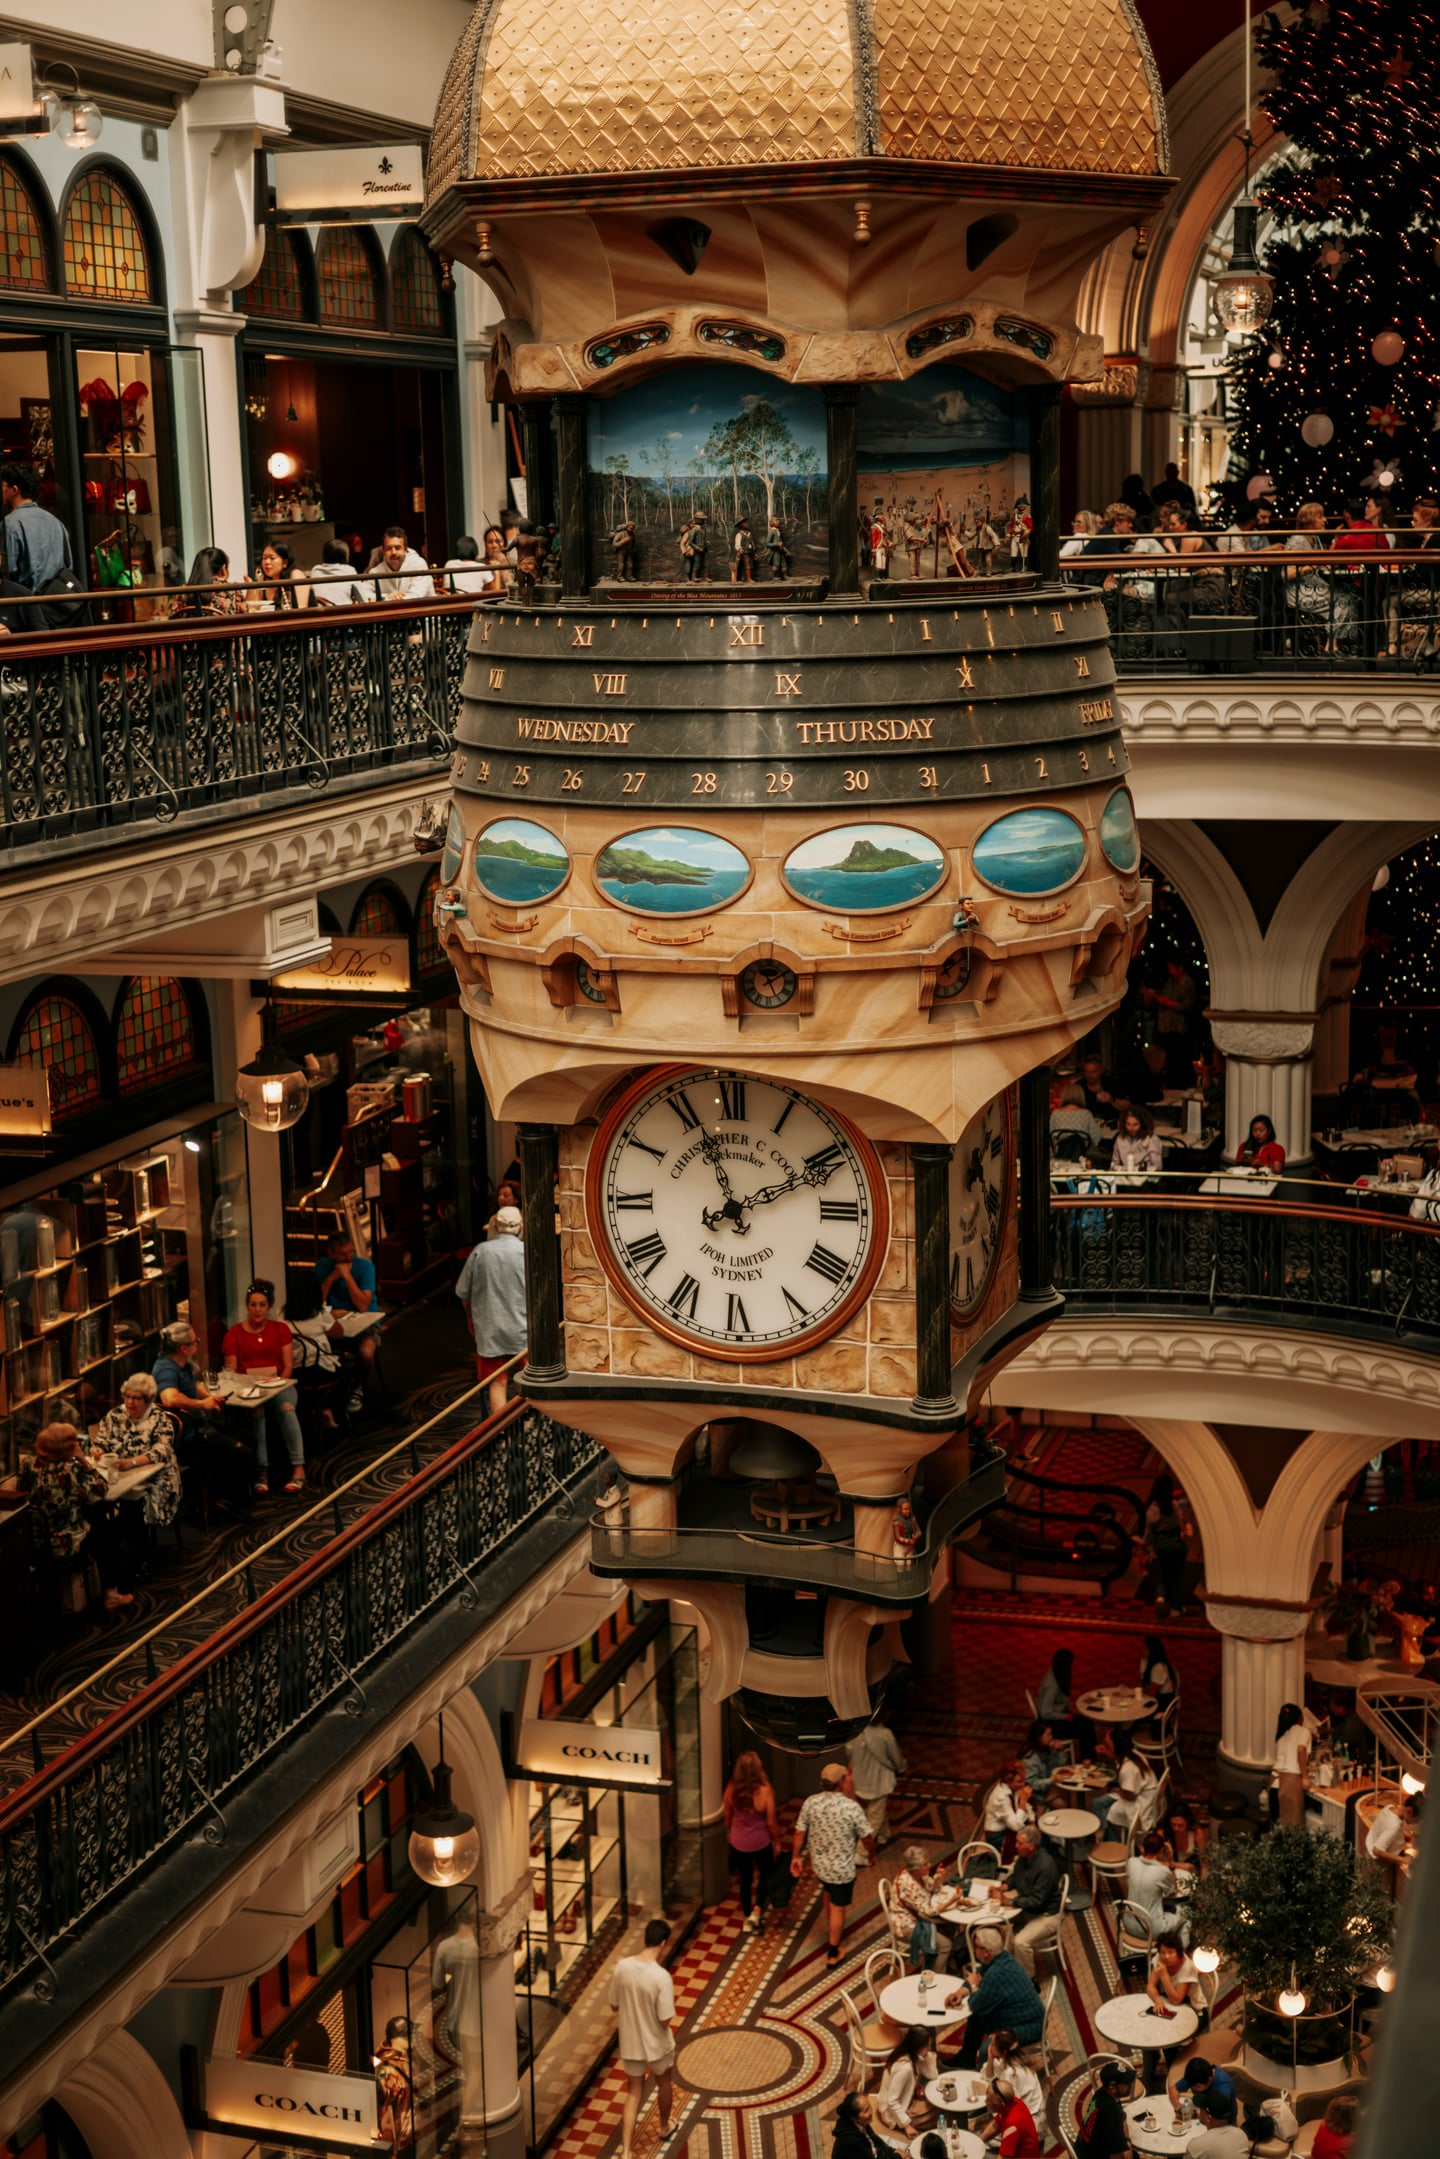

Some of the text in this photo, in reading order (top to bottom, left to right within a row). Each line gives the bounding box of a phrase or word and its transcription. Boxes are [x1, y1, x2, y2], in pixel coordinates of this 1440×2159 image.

[362, 181, 412, 195] Florentine
[572, 625, 595, 647] XI
[730, 624, 765, 646] XII
[1050, 612, 1065, 633] II
[489, 668, 505, 689] VII
[592, 673, 628, 695] VIII
[775, 673, 802, 695] IX
[956, 667, 975, 689] X
[517, 718, 635, 744] WEDNESDAY
[797, 718, 935, 744] THURSDAY
[477, 761, 490, 782] 24
[512, 765, 531, 786] 25
[561, 769, 584, 791] 26
[622, 772, 647, 793] 27
[691, 772, 717, 794] 28
[765, 772, 794, 794] 29
[843, 770, 869, 791] 30
[918, 767, 939, 788] 31
[982, 763, 992, 785] 1
[1035, 757, 1048, 779] 2
[1078, 751, 1089, 772] 3
[665, 1089, 704, 1135] XI
[715, 1080, 749, 1121] XII
[626, 1131, 668, 1166] X
[670, 1133, 749, 1180] CHRISTPHER
[702, 1148, 766, 1169] Cckmaker
[616, 1185, 654, 1214] IX
[819, 1196, 859, 1224] III
[699, 1242, 774, 1267] IPOH LIMITED
[711, 1265, 763, 1282] SYDNEY
[664, 1270, 701, 1321] VII
[725, 1292, 755, 1333] VI
[562, 1745, 650, 1765] COACH
[254, 2093, 362, 2123] COACH
